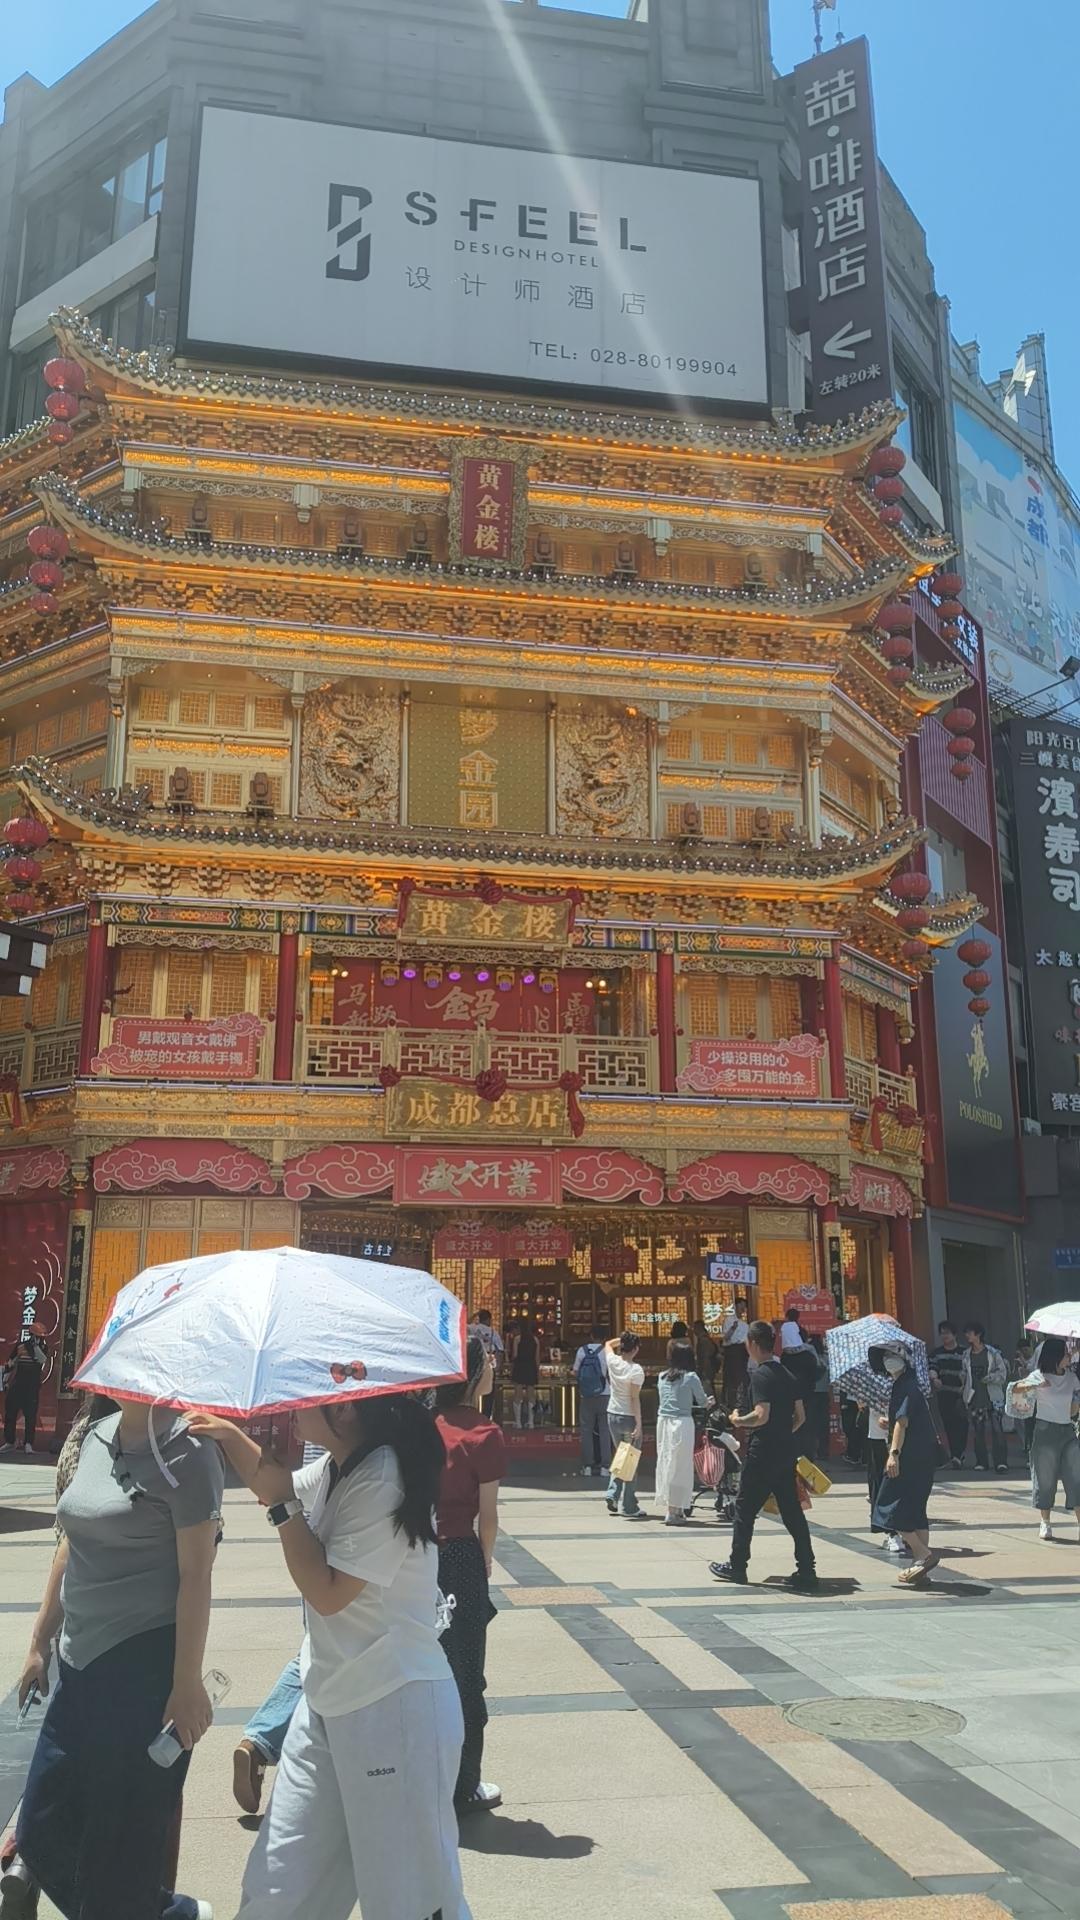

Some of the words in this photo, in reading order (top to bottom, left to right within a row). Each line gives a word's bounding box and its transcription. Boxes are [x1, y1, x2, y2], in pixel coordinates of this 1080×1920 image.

[404, 190, 647, 253] SFEEL
[453, 239, 599, 268] DESIGNHOTEL
[404, 265, 647, 317] 设计师酒店
[590, 347, 738, 377] 028-80199904
[818, 363, 882, 396] 左转20米
[1026, 730, 1080, 752] 阳光百
[137, 1030, 237, 1048] 男戴观音女戴佛
[707, 1050, 790, 1068] 少操没用的心
[405, 1089, 560, 1129] 成都总店
[716, 1267, 740, 1280] 26.9
[367, 1767, 396, 1777] adidas
